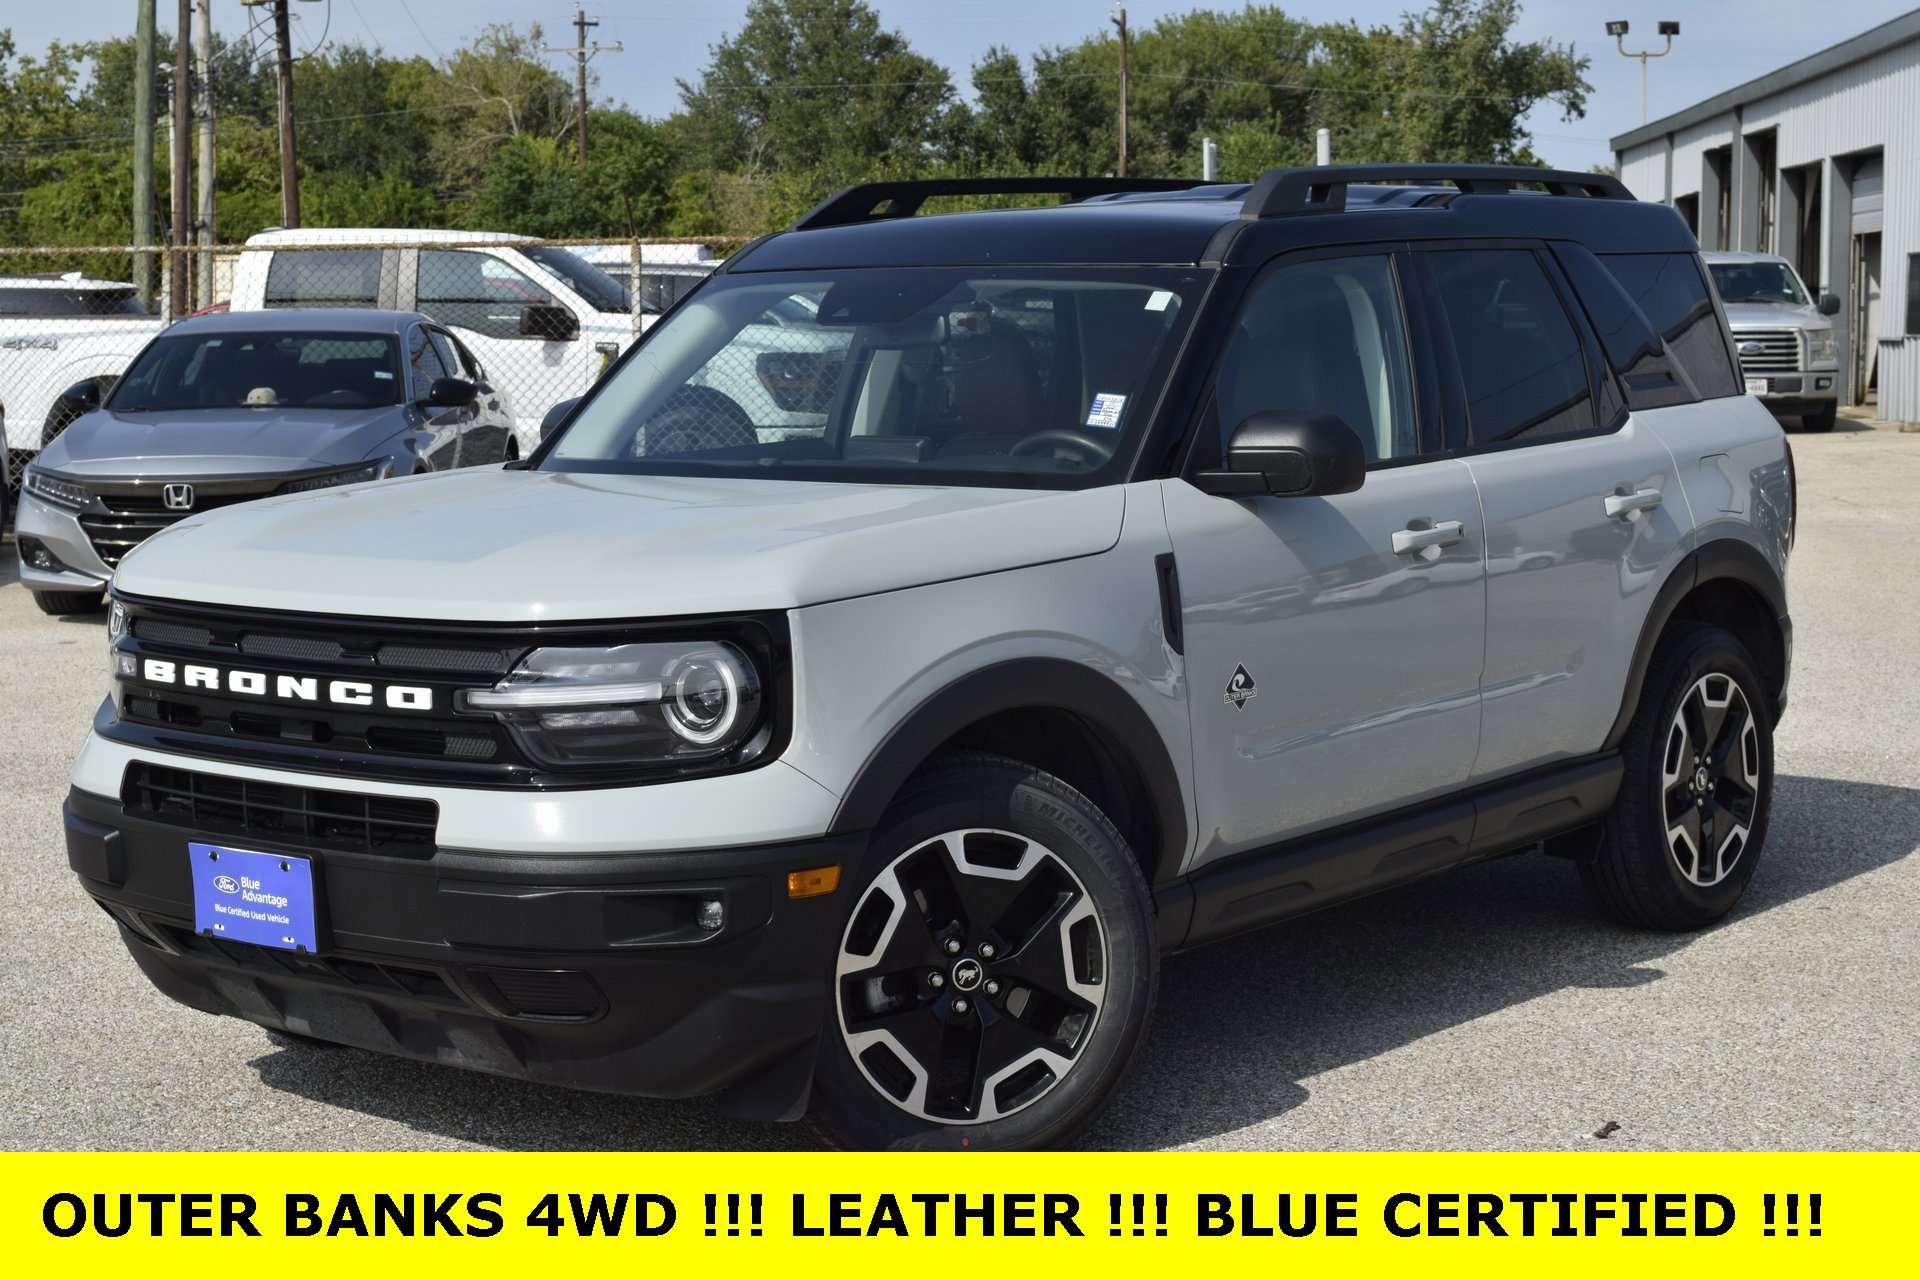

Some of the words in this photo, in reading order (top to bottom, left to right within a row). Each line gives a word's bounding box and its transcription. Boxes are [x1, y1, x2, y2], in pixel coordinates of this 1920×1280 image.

[144, 658, 433, 711] BRONCO
[1038, 802, 1120, 880] MICHELIN
[217, 877, 236, 892] Ford
[241, 876, 261, 890] Blue
[242, 889, 288, 908] Advantage
[214, 903, 228, 914] Blue
[228, 906, 250, 919] Certified
[251, 911, 266, 920] Used
[267, 914, 290, 925] Vehicle
